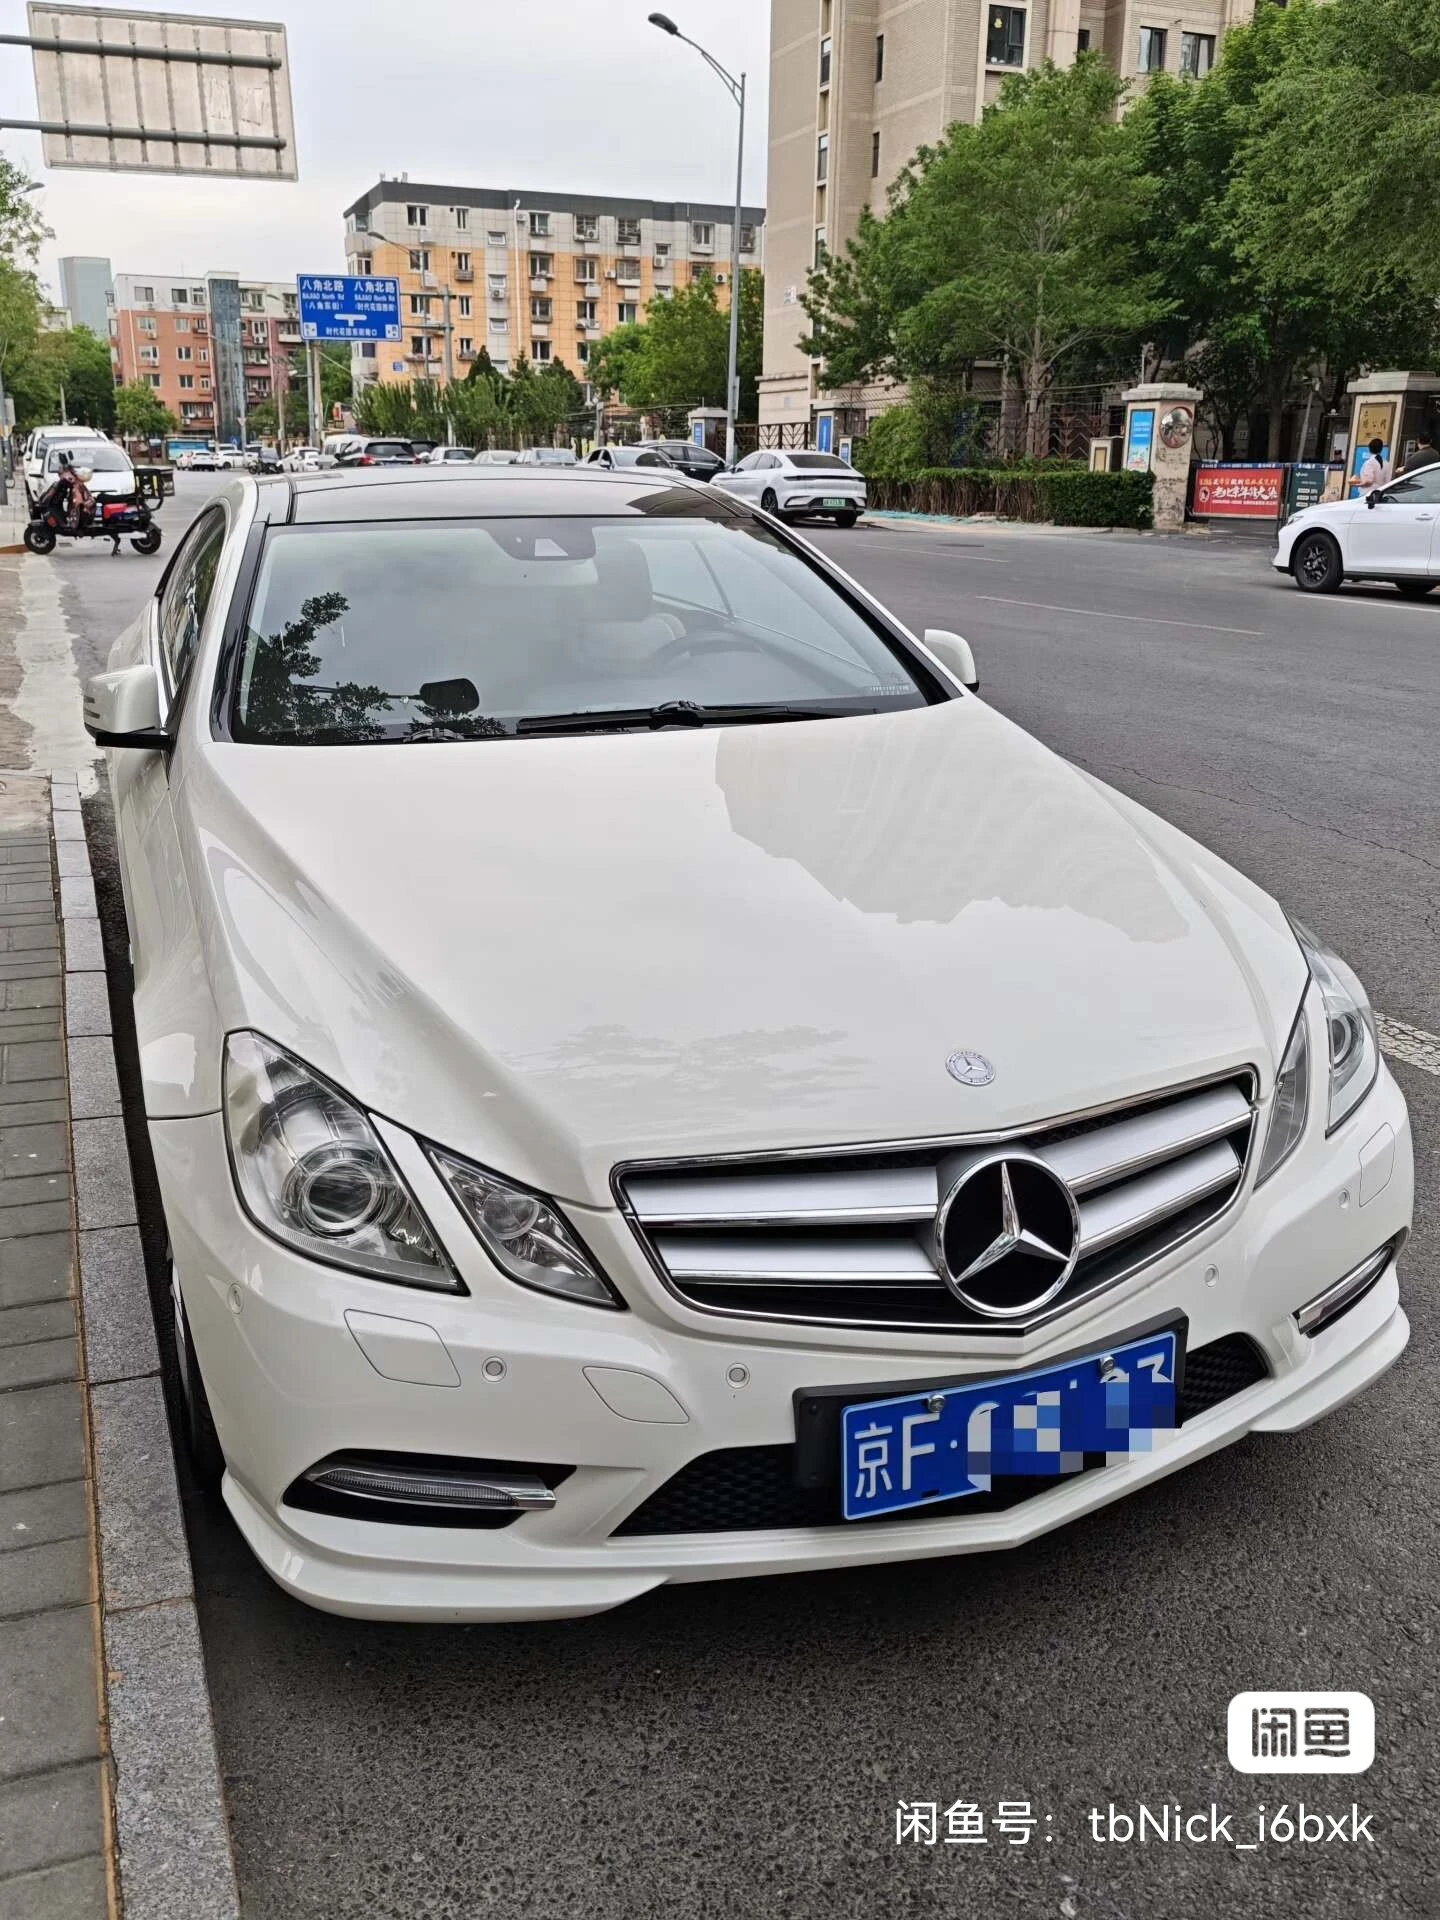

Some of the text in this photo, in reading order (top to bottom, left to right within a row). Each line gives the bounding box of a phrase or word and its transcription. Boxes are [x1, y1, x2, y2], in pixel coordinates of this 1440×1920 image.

[302, 279, 344, 292] 八角北路
[354, 281, 395, 293] 八角北路
